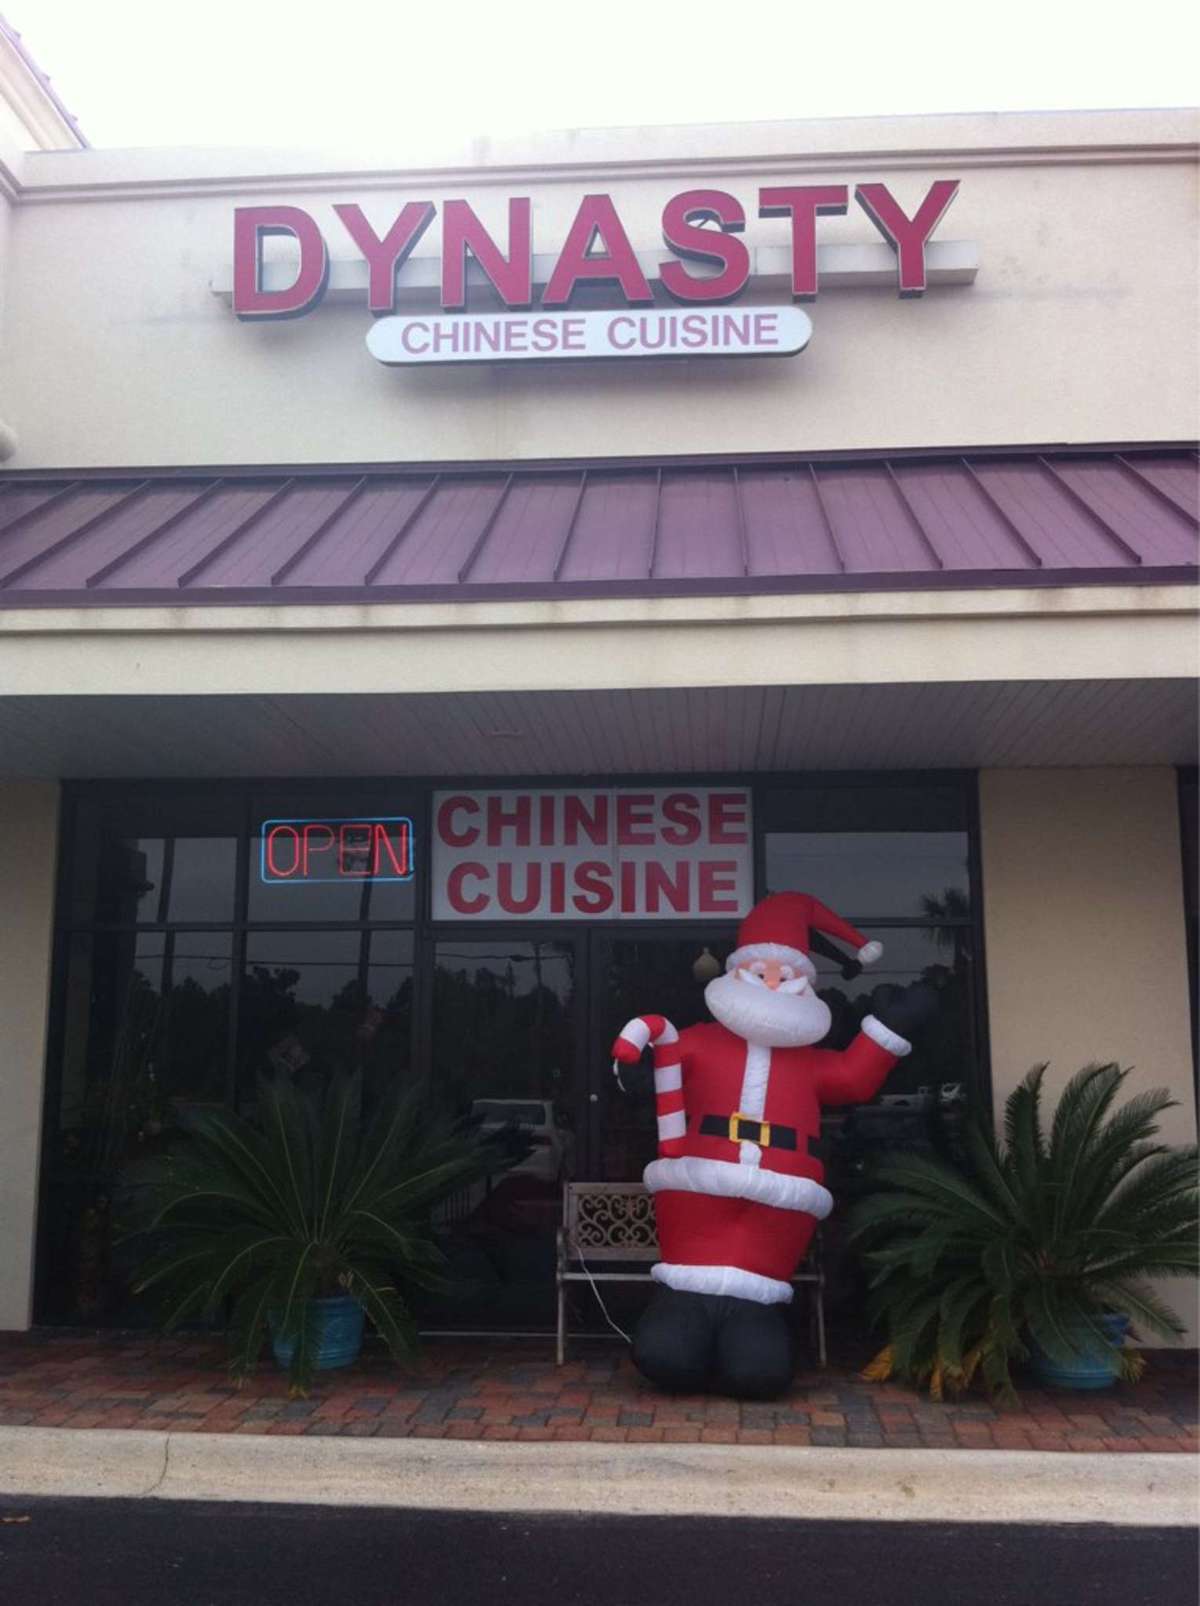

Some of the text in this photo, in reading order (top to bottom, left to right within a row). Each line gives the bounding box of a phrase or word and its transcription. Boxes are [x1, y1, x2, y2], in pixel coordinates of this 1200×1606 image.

[233, 180, 960, 318] DYNASTY
[401, 313, 780, 354] CHINESE CUISINE
[437, 791, 748, 848] CHINESE
[266, 824, 407, 877] OPEN
[446, 860, 739, 915] CUISINE
